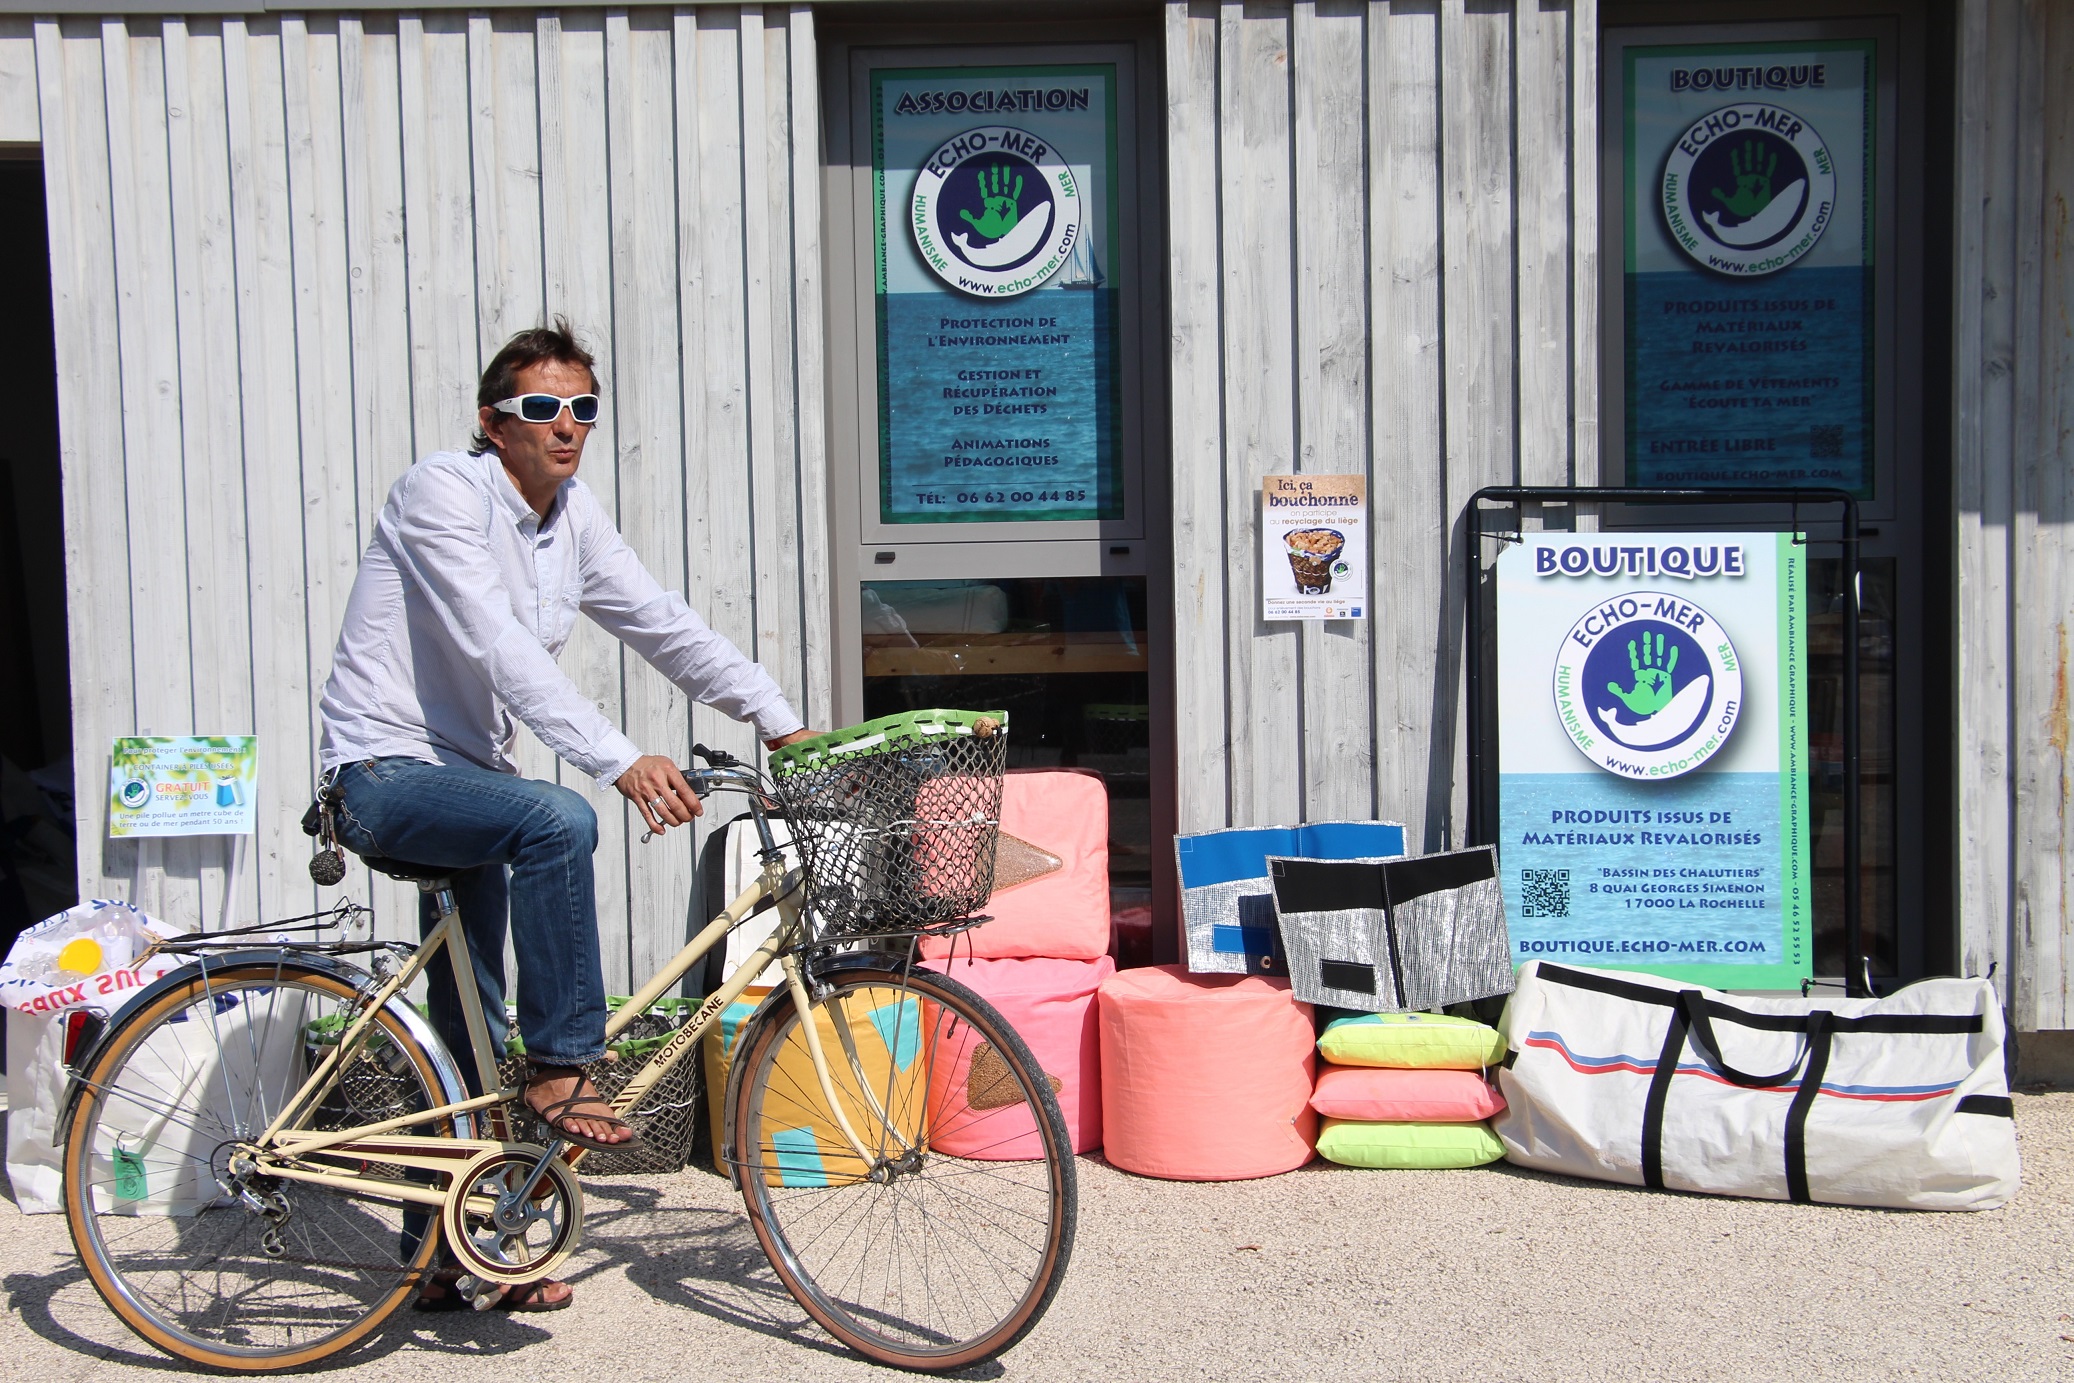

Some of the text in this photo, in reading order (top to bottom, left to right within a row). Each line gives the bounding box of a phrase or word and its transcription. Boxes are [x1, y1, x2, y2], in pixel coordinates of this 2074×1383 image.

[1673, 64, 1825, 91] BOUTIQUE
[896, 88, 1089, 114] ASSOCIATION
[1679, 108, 1803, 157] ECHO-MER
[926, 130, 1047, 179] ECHO-MER
[1813, 147, 1831, 175] MER
[1058, 170, 1076, 198] MER
[1665, 173, 1699, 251] HUMANISME
[914, 194, 948, 272] HUMANISME
[1709, 201, 1831, 273] www.echo-mer.com
[959, 223, 1076, 294] www.echo-mer.com
[1664, 298, 1836, 314] PRODUITS ISSUS DE
[940, 317, 1057, 329] PROTECTION DE
[928, 334, 1070, 347] L'ENVIRONNEMENT
[1692, 337, 1807, 354] REVALORISÉS
[957, 369, 1041, 381] GESTION ET
[943, 384, 1057, 399] RÉCUPÉRATION
[1660, 380, 1720, 391] GAMME
[1725, 379, 1744, 390] DE
[953, 401, 1047, 415] DES DÉCHETS
[1751, 396, 1772, 408] TA
[951, 438, 1050, 450] ANIMATIONS
[1651, 437, 1776, 454] ENTRÉE LIBRE
[944, 455, 1059, 467] PÉDAGOGIQUES
[1656, 469, 1842, 481] BOUTIQUE.ECHO-MER.COM
[1278, 479, 1313, 494] Ici, ça
[916, 489, 1086, 504] TÉL: 06 62 00 44 85
[1282, 517, 1322, 526] recyclage
[1338, 517, 1359, 526] liège
[1302, 510, 1337, 519] participe
[1535, 545, 1743, 577] BOUTIQUE
[1787, 557, 1796, 592] RÉALISÉ
[1572, 597, 1705, 649] ECHO-MER
[1717, 642, 1738, 672] MER
[1788, 664, 1796, 718] GRAPHIQUE
[1557, 664, 1594, 751] HUMANISME
[1606, 699, 1737, 777] www.echo-mer.com
[155, 781, 210, 793] GRATUIT
[1789, 725, 1798, 880] WWW.AMBIANCE-GRAPHIQUE.COM
[135, 812, 150, 821] pile
[152, 811, 176, 820] pollue
[180, 819, 210, 827] pendant
[1551, 809, 1731, 824] PRODUITS ISSUS DE
[1522, 829, 1762, 845] MATÉRIAUX REVALORISÉS
[1653, 868, 1676, 878] DES
[1679, 867, 1765, 878] CHALUTIERS"
[1589, 883, 1765, 895] 8 QUAI GEORGES SIMENON
[1792, 887, 1799, 900] 05
[1679, 899, 1695, 909] LA
[1699, 899, 1765, 909] ROCHELLE
[1792, 904, 1799, 917] 46
[1792, 921, 1799, 933] 52
[1520, 940, 1766, 953] BOUTIQUE.ECHO-MER.COM
[1793, 936, 1800, 949] 55
[1793, 952, 1800, 965] 53
[653, 995, 724, 1068] MOTOBECANE
